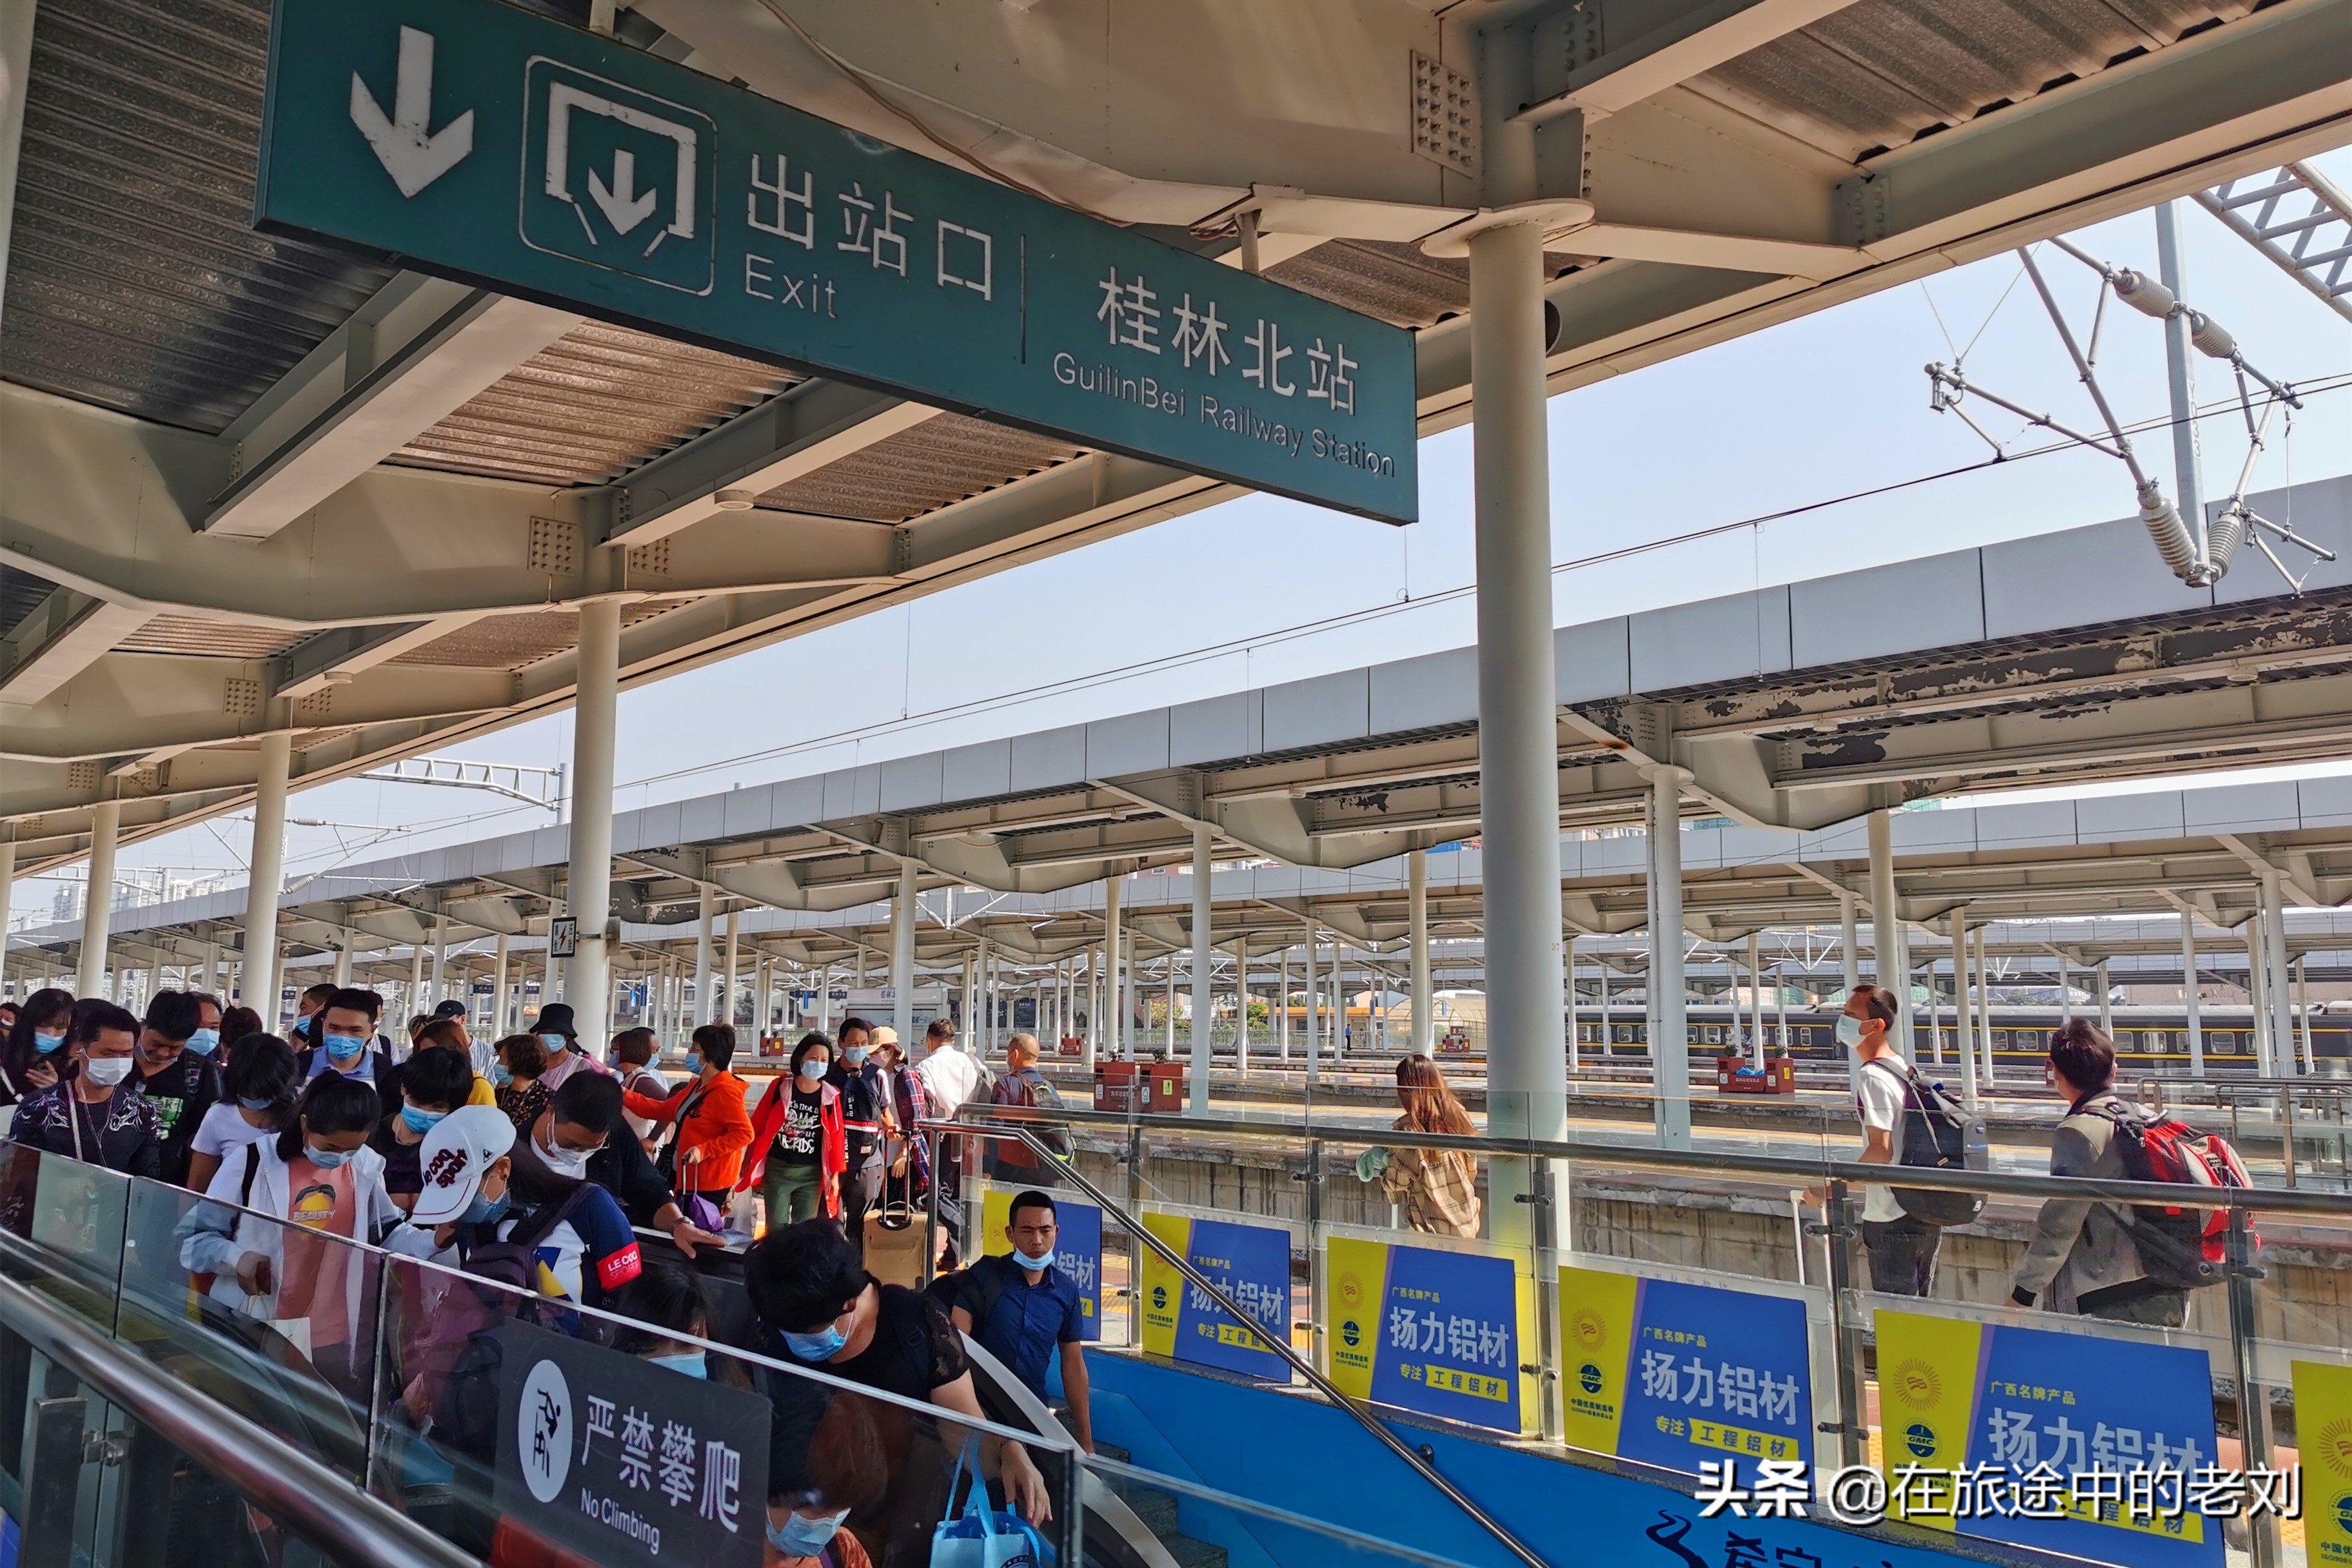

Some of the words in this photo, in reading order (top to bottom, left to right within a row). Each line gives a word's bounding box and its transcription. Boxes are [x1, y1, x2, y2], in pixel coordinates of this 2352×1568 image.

[747, 153, 993, 302] 出站口
[746, 253, 838, 319] Exit
[1097, 266, 1359, 416] 桂林北站
[1052, 352, 1186, 418] GuilinBei
[1200, 394, 1304, 458] Railway
[1312, 428, 1395, 478] Station
[293, 1210, 336, 1221] BEAUTY
[608, 1259, 622, 1271] LE
[1392, 1286, 1440, 1303] 广西名牌产品
[1198, 1322, 1215, 1338] 专注
[1390, 1306, 1509, 1368] 扬力铝材
[1643, 1326, 1707, 1348] 广西名牌产品
[1400, 1363, 1422, 1381] 专注
[1434, 1371, 1499, 1396] 工程铝材
[1582, 1375, 1601, 1383] GMC
[1641, 1349, 1800, 1426] 扬力铝材
[1991, 1380, 2076, 1406] 广西名牌产品
[1655, 1415, 1685, 1436] 专注
[1700, 1426, 1786, 1458] 工程铝材
[1908, 1436, 1934, 1446] GMC
[582, 1395, 740, 1533] 严禁攀爬
[581, 1487, 598, 1518] No
[601, 1498, 660, 1555] Climbing
